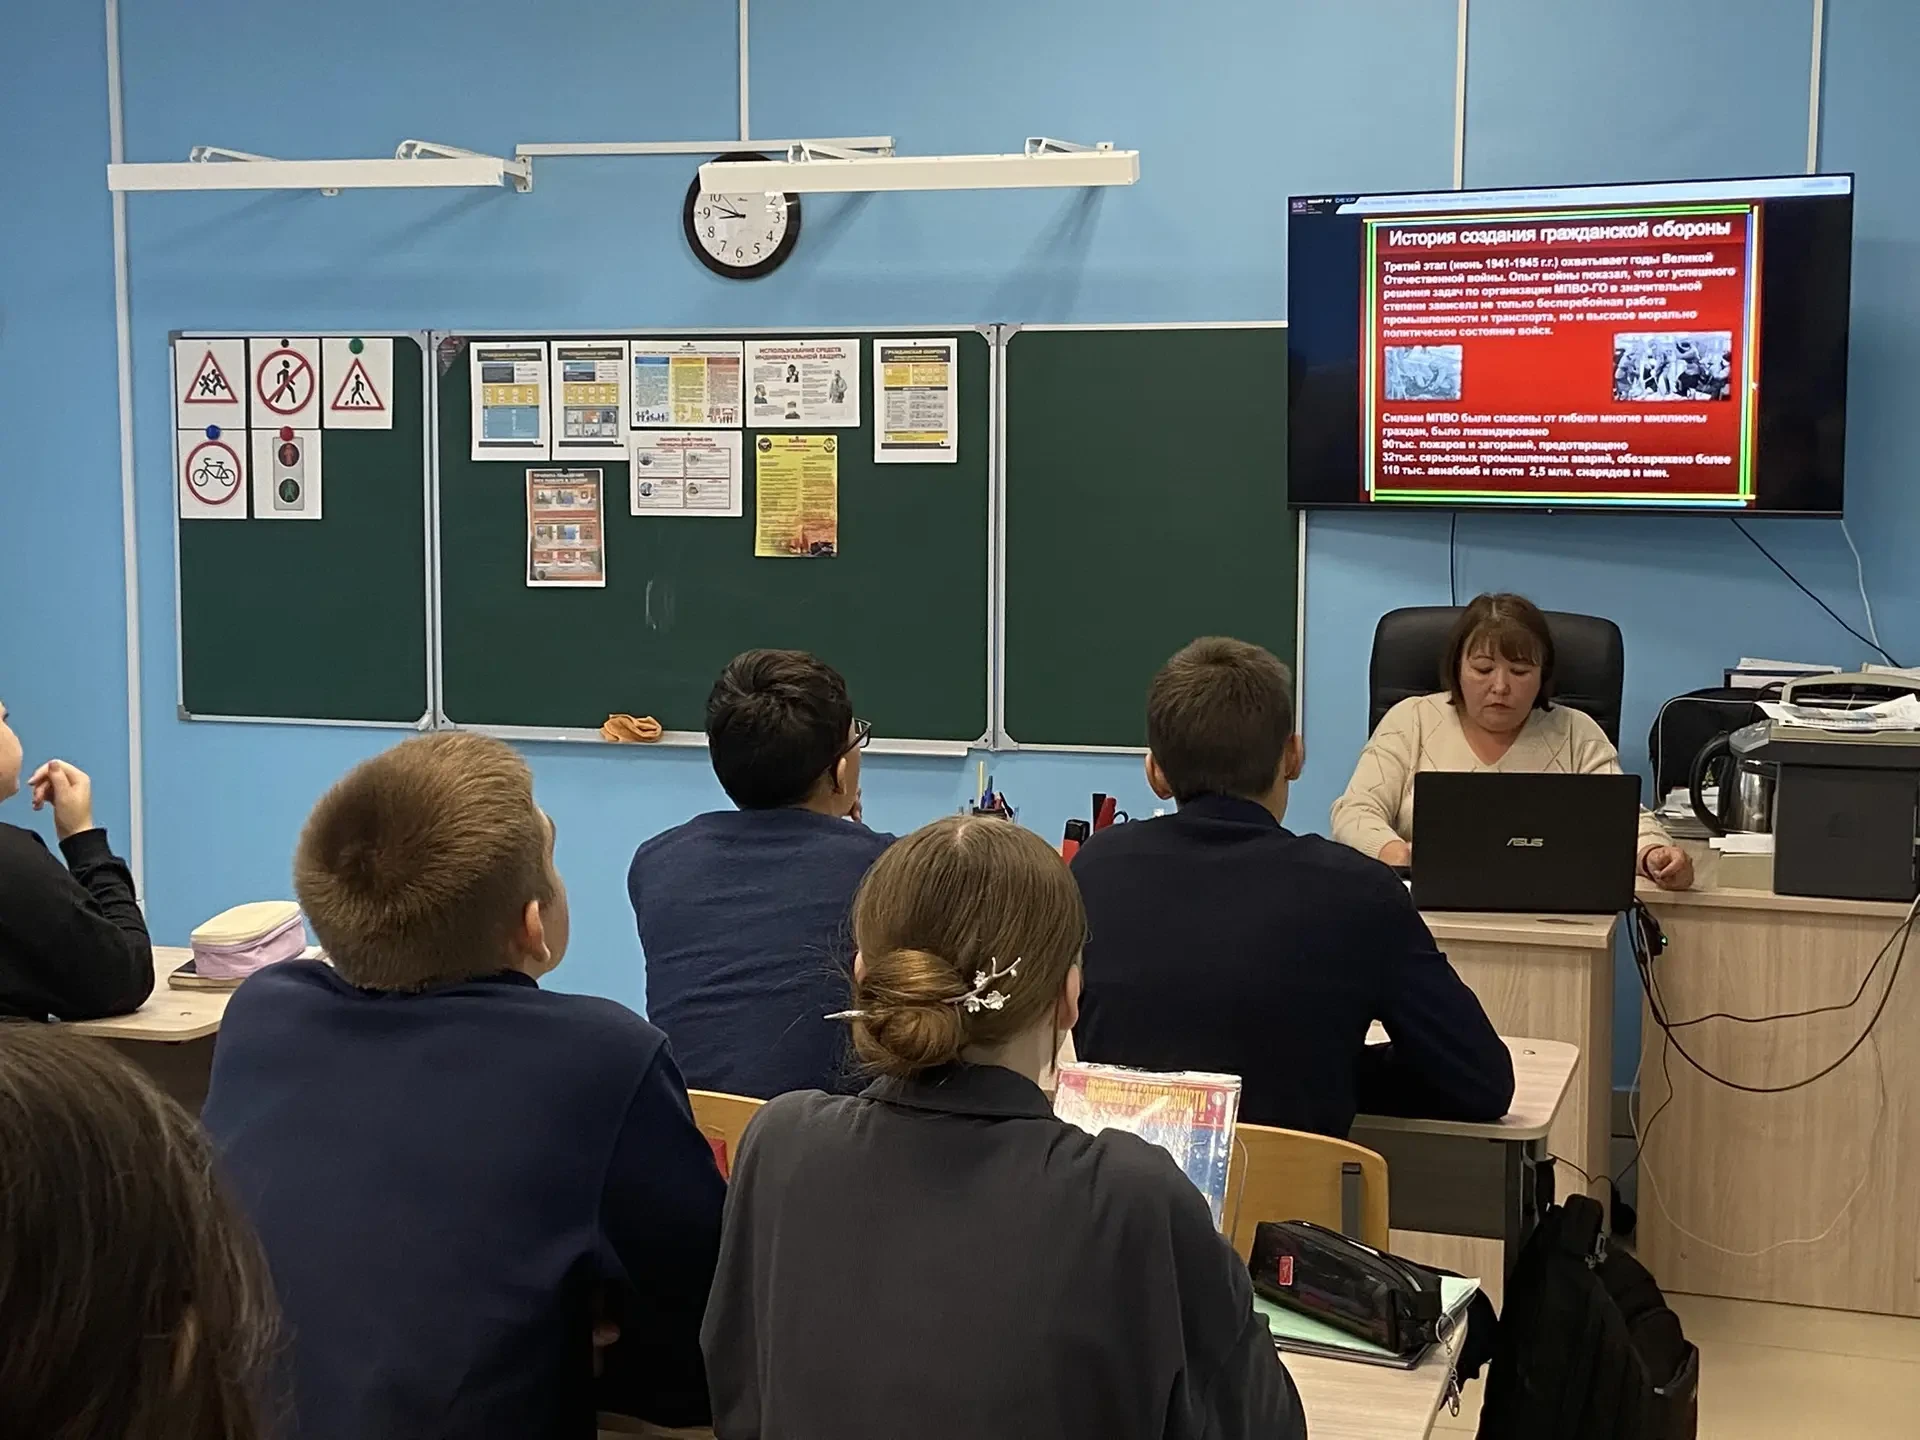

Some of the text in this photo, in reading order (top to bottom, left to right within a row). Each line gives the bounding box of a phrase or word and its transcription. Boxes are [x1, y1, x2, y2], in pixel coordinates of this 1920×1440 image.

[703, 207, 711, 219] 9
[773, 212, 781, 224] 3
[707, 226, 715, 239] 8
[766, 230, 774, 242] 4
[1389, 220, 1732, 249] История создания гражданской обороны
[720, 240, 728, 253] 7
[735, 246, 743, 258] 6
[753, 242, 761, 254] 5
[1384, 261, 1421, 273] Третий
[1424, 262, 1447, 271] этап
[1450, 260, 1482, 272] (июнь
[1486, 258, 1539, 268] 1941-1945
[1561, 256, 1628, 267] охватывает
[1630, 256, 1660, 267] годы
[1662, 252, 1714, 264] Великой
[1384, 267, 1736, 285] Отечественной войны. Опыт войны показал, что от успешного
[1384, 281, 1702, 300] решения задач по организации МПВО-ГО в значительной
[1384, 296, 1667, 312] степени зависела не только бесперебойная работа
[1384, 310, 1698, 326] промышленности и транспорта, но и высокое морально
[1384, 326, 1554, 338] политическое состояние войск.
[1382, 412, 1707, 424] Силами МПВО были спасены от гибели многие миллионы
[1382, 426, 1550, 438] граждан, было ликвидировано
[1382, 439, 1418, 449] 90тыс.
[1420, 440, 1466, 450] пожаров
[1468, 441, 1476, 449] и
[1538, 440, 1629, 452] предотвращено
[1382, 452, 1732, 465] 32тыс. серьезных промышленных аварий, обезврежено более
[1382, 465, 1670, 479] 110 тыс. авиабомб и почти 2,5 млн. снарядов и мин.
[1506, 838, 1544, 847] ASUS
